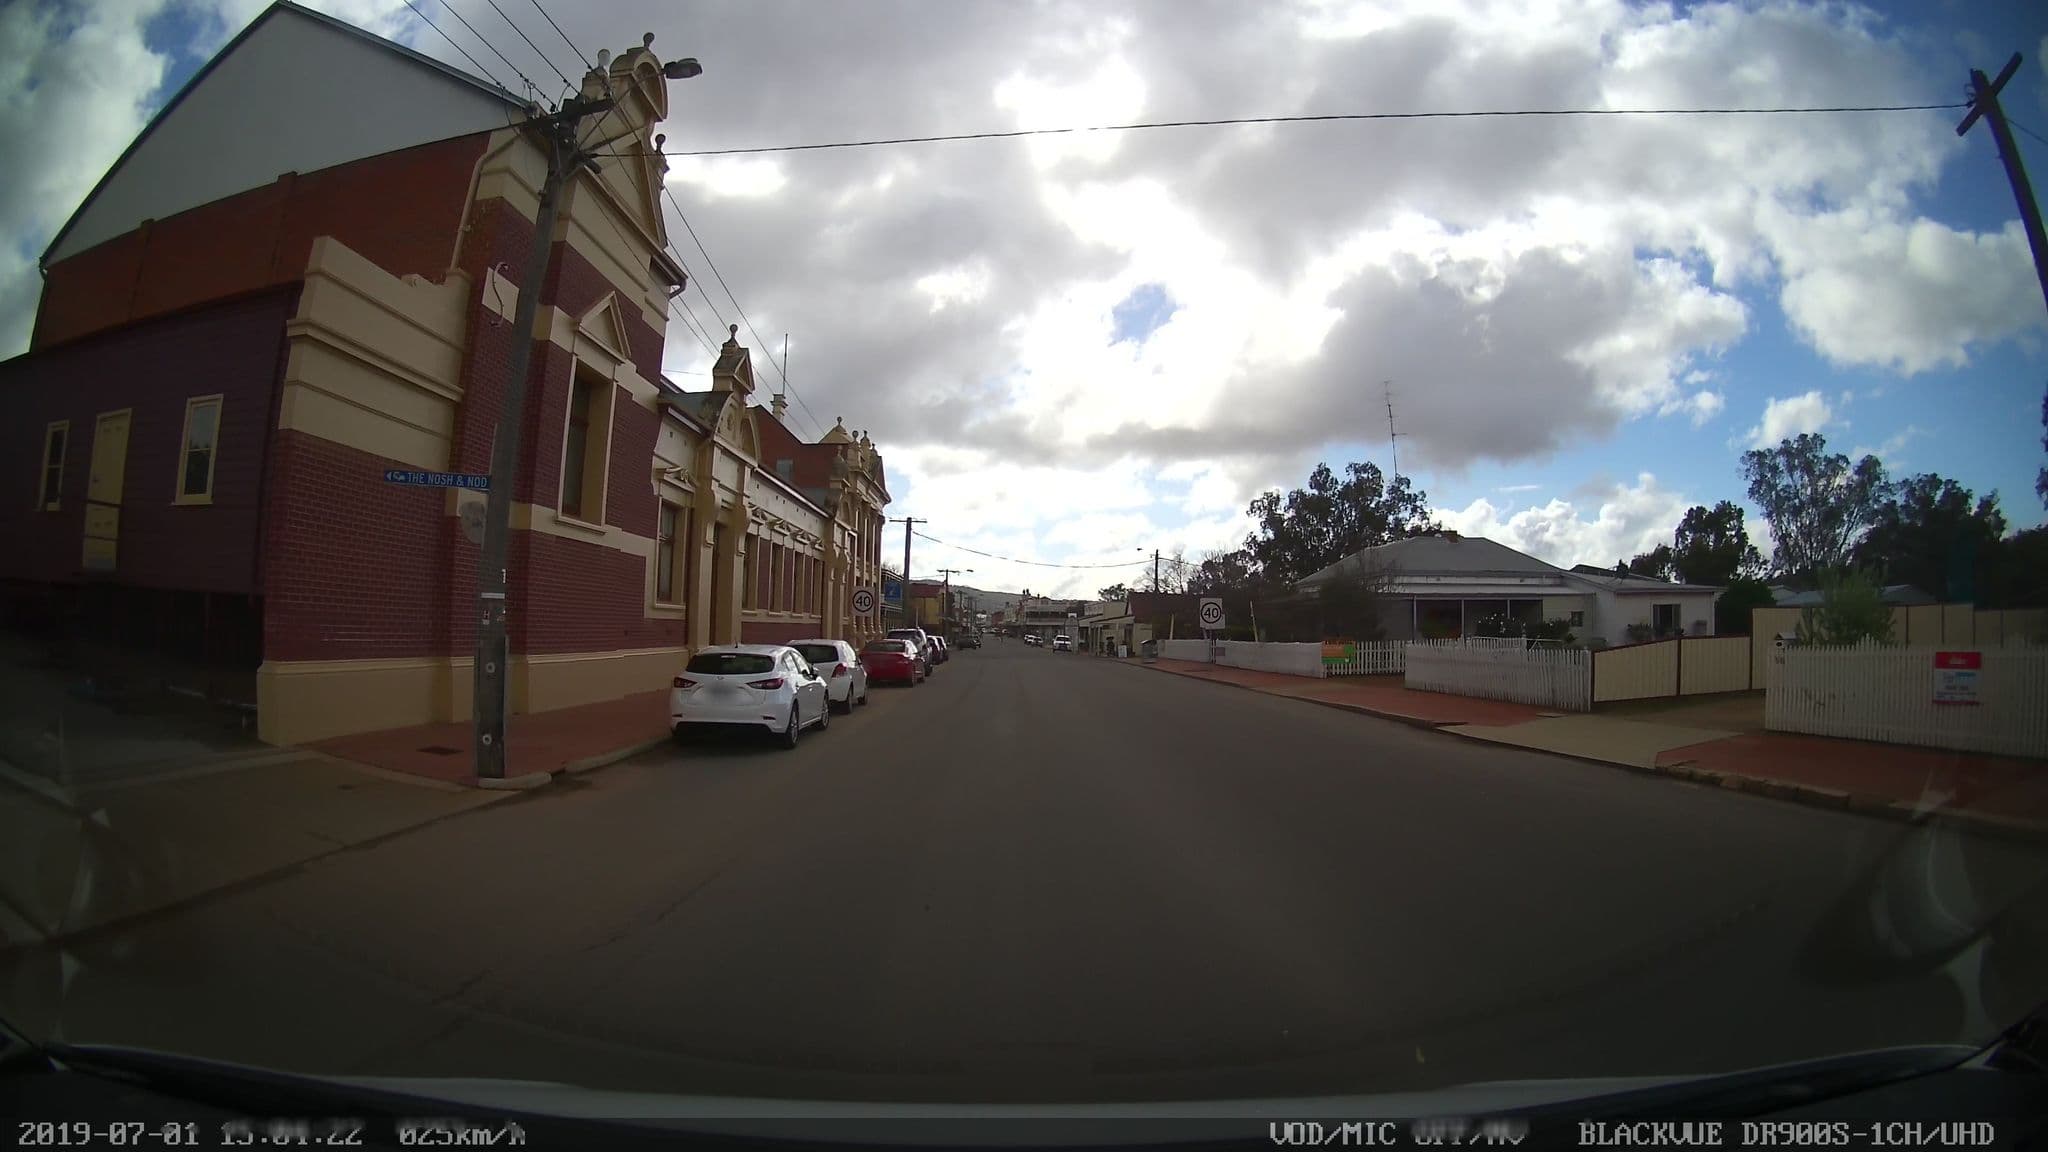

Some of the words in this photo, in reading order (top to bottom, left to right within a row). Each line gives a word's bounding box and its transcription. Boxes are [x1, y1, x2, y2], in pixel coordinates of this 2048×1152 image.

[408, 472, 425, 484] THE
[428, 473, 454, 486] NOSH
[456, 475, 465, 487] &
[467, 476, 488, 488] NOD
[855, 595, 871, 607] 40
[1203, 607, 1219, 619] 40
